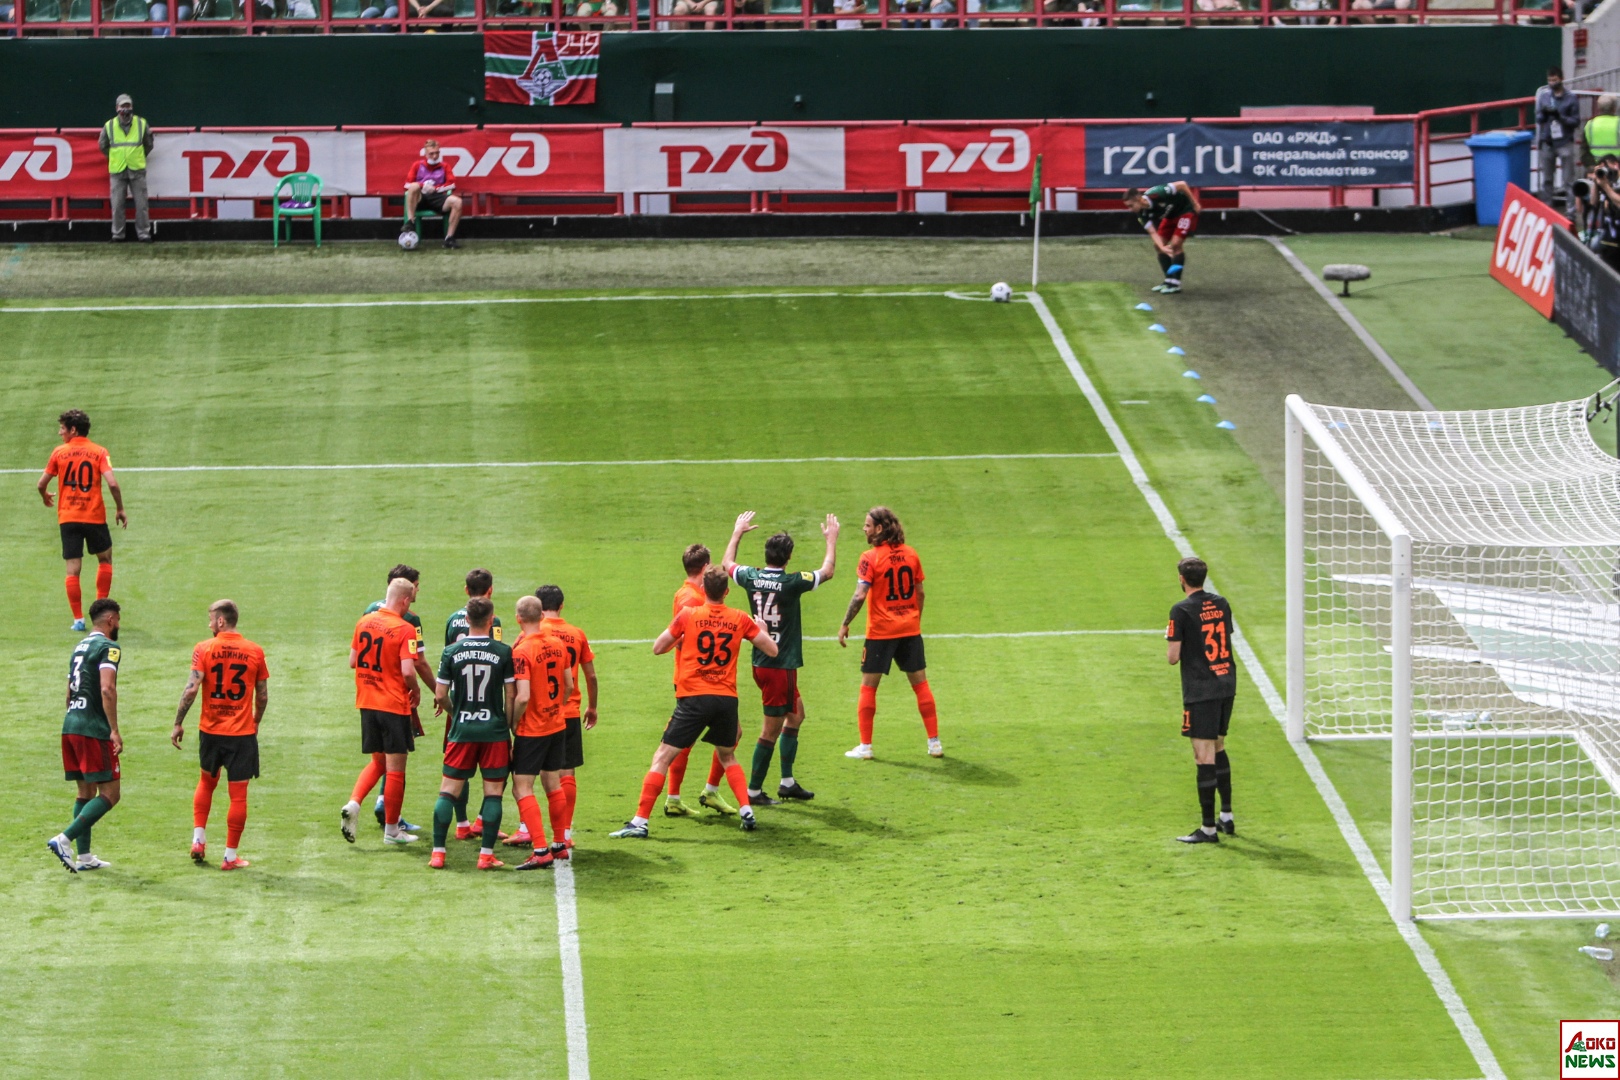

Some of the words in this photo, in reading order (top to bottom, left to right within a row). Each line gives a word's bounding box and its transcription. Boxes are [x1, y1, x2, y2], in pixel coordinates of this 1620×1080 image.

[1103, 133, 1242, 175] rzd.ru
[1252, 132, 1284, 145] ОАО
[1287, 132, 1338, 145] «РЖД»
[1252, 148, 1346, 162] генеральный
[1350, 150, 1409, 162] спонсор
[1253, 164, 1277, 177] ФК
[1280, 164, 1377, 177] «Локомотив»
[63, 461, 93, 492] 40
[753, 579, 782, 592] ЧОРЛУКА
[884, 565, 915, 601] 10
[695, 619, 739, 632] ГЕРАСИМОВ
[753, 591, 781, 628] 14
[211, 650, 250, 662] КАЛИНИН
[357, 631, 384, 673] 21
[452, 650, 501, 664] ЖЕМАЛЕТДИНОВ
[696, 630, 734, 667] 93
[1201, 621, 1230, 662] 31
[69, 655, 84, 692] 3
[210, 662, 249, 701] 13
[461, 663, 492, 702] 17
[546, 661, 560, 700] 5
